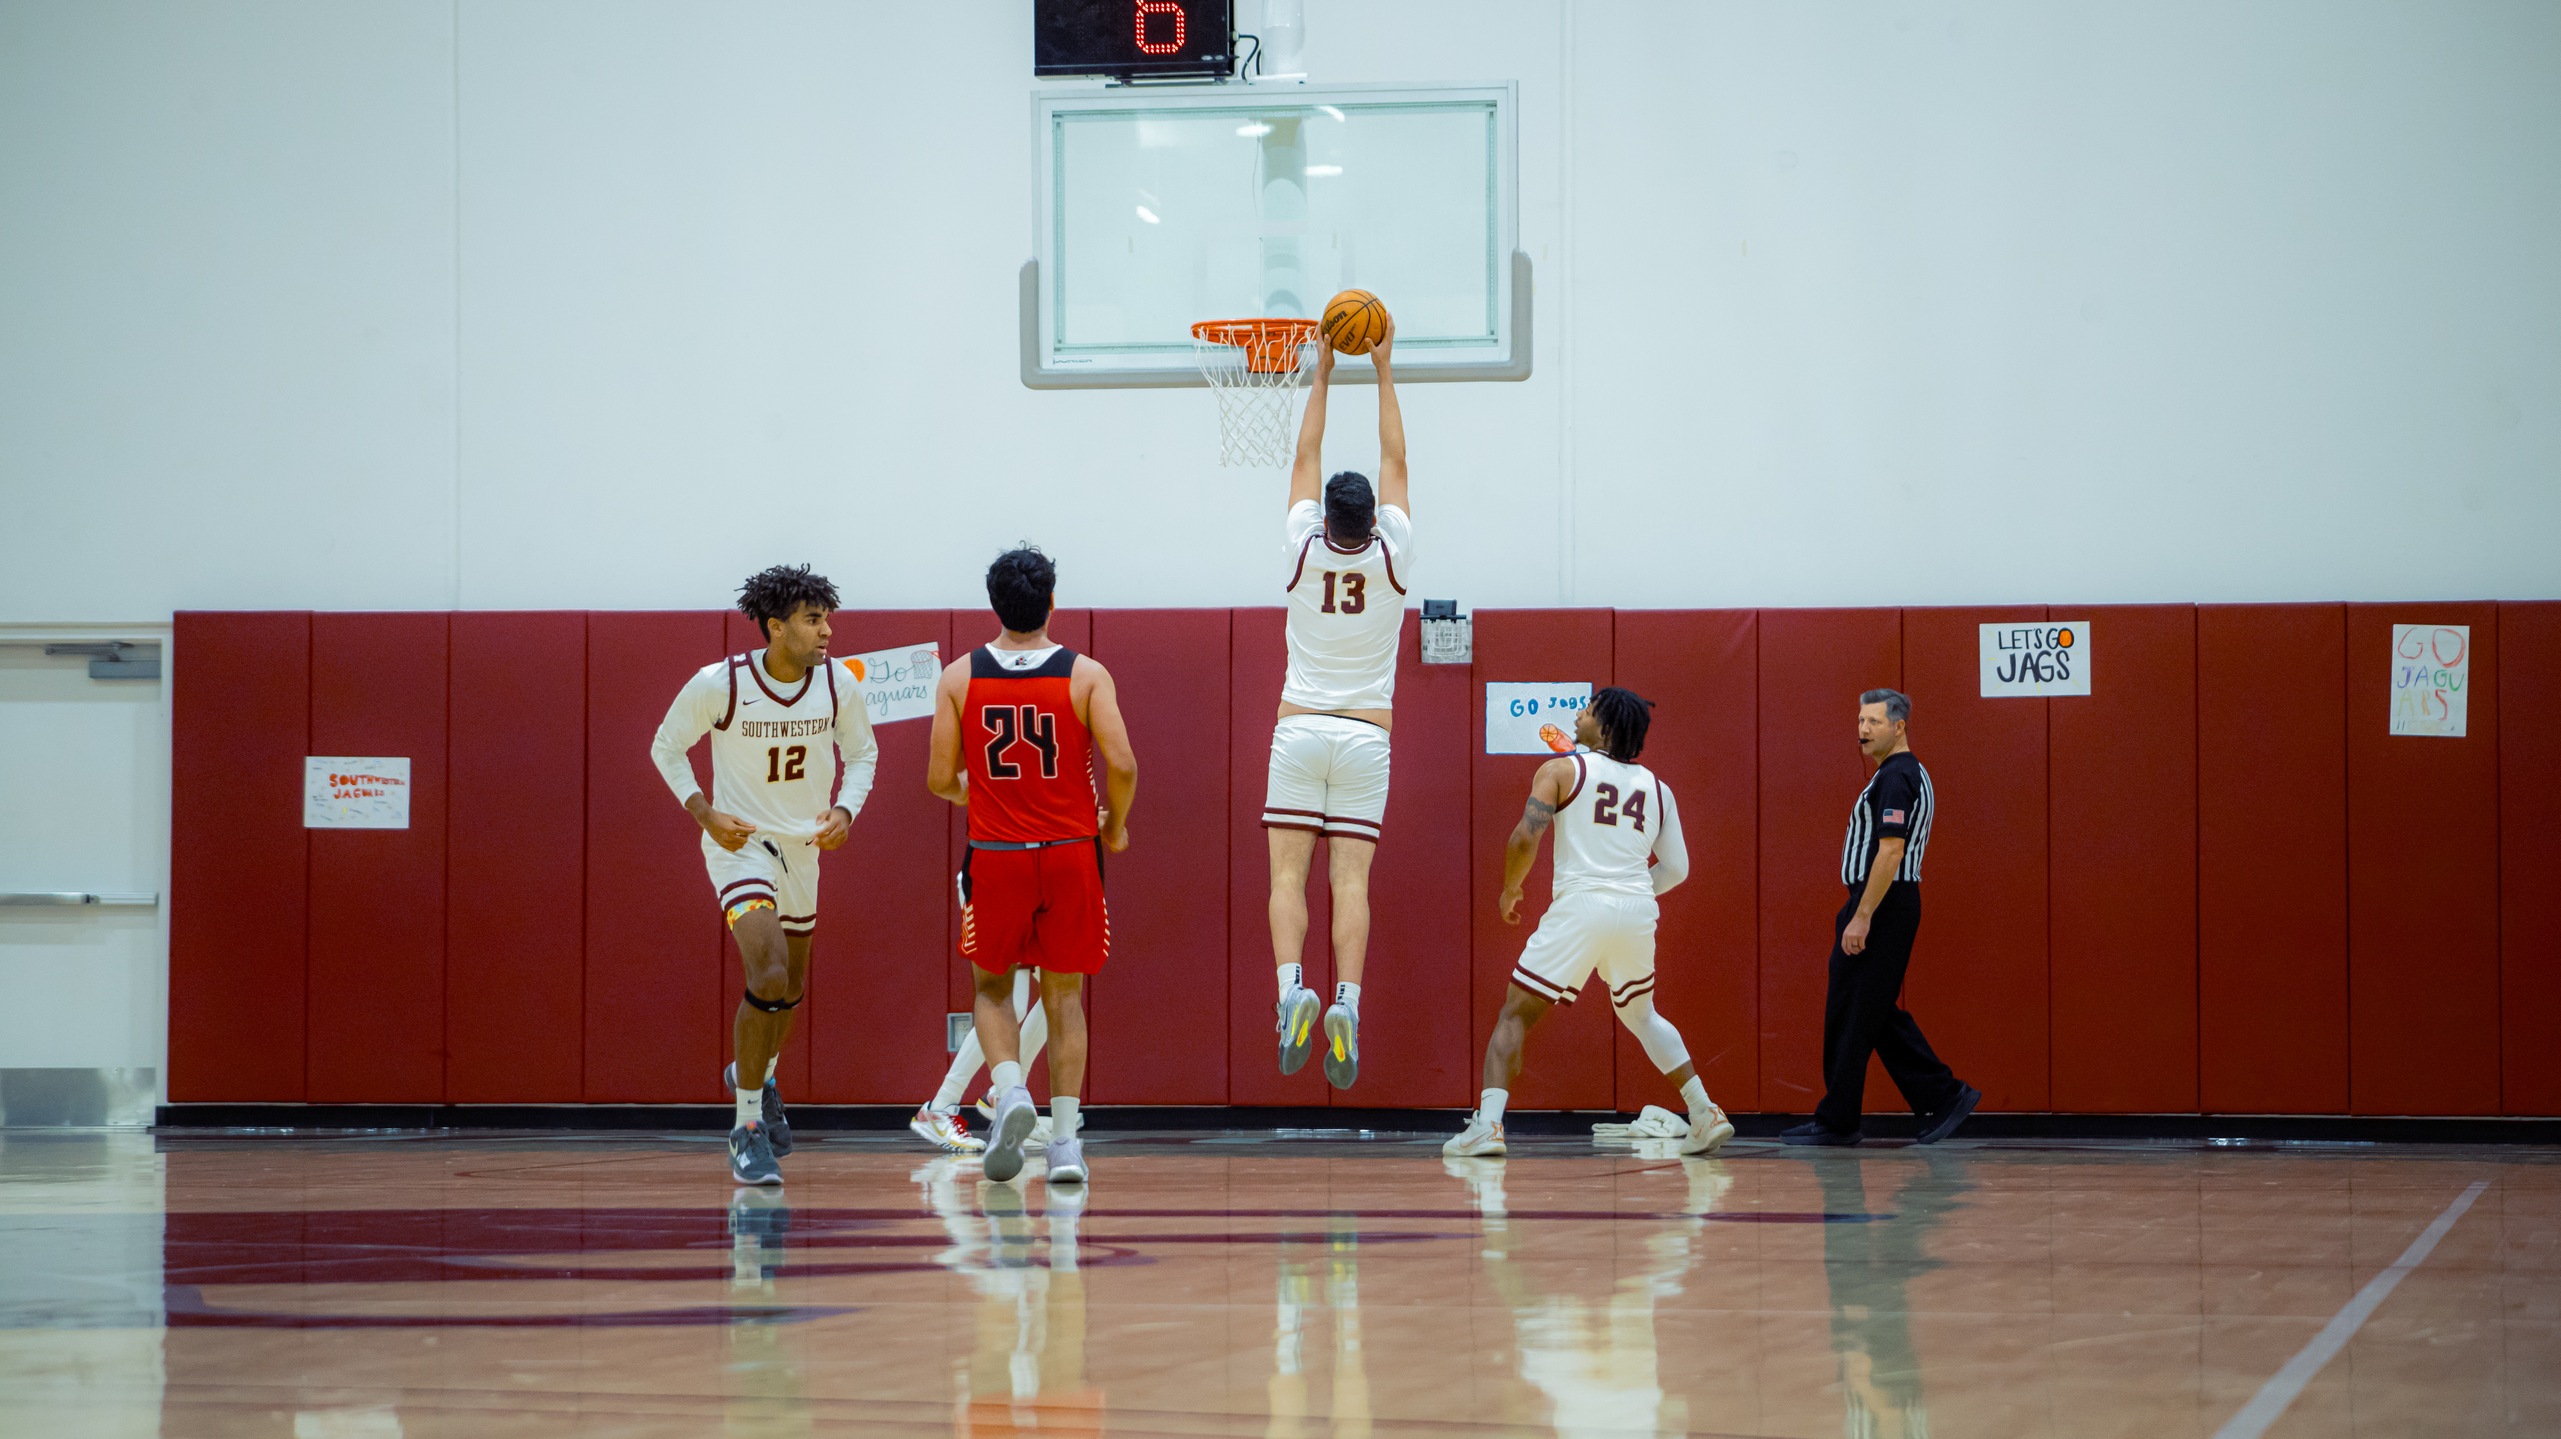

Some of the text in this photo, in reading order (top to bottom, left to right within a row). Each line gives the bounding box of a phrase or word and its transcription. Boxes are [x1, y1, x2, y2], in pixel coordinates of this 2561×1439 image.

[1320, 570, 1367, 615] 13
[2046, 627, 2075, 650] GO
[2397, 626, 2466, 668] GO
[868, 657, 916, 684] Go
[1996, 649, 2070, 683] JAGS
[865, 685, 928, 717] aguars
[1510, 698, 1539, 717] GO
[742, 717, 830, 738] SOUTHWESTERN
[982, 704, 1059, 780] 24
[767, 745, 807, 783] 12
[1593, 782, 1647, 834] 24
